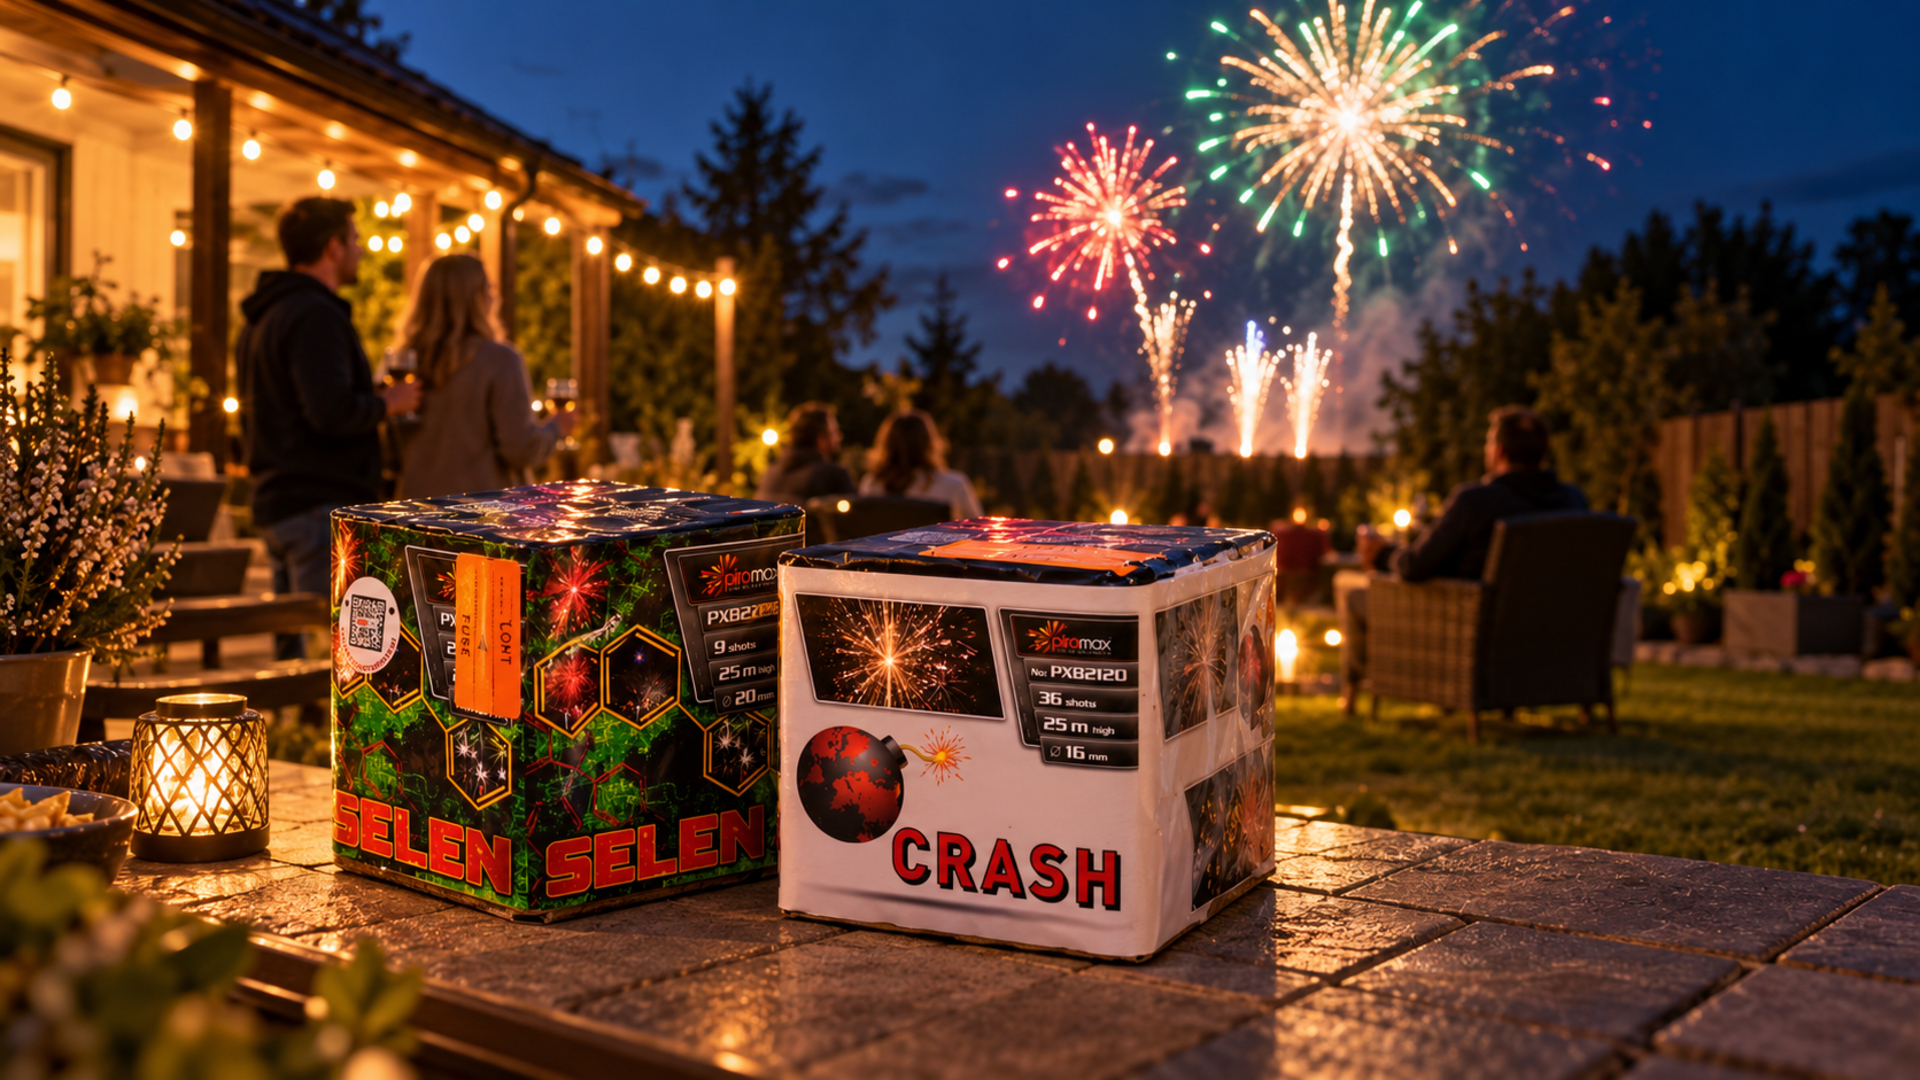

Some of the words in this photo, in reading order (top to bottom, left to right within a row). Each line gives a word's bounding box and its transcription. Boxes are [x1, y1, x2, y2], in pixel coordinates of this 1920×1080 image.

[714, 640, 726, 655] 9
[728, 641, 757, 653] shots
[1052, 634, 1112, 652] piromax
[719, 664, 741, 681] 25
[743, 666, 757, 678] m
[1050, 665, 1127, 682] PXB2120
[735, 689, 756, 706] 20
[757, 692, 775, 701] mm
[1039, 691, 1062, 706] 36
[1065, 698, 1097, 708] shots
[1043, 716, 1067, 732] 25
[1071, 722, 1088, 733] m
[1066, 745, 1085, 760] 16
[1088, 753, 1108, 761] mm
[333, 789, 512, 896] SELEN
[546, 804, 765, 898] SELEN
[892, 827, 1121, 911] CRASH
